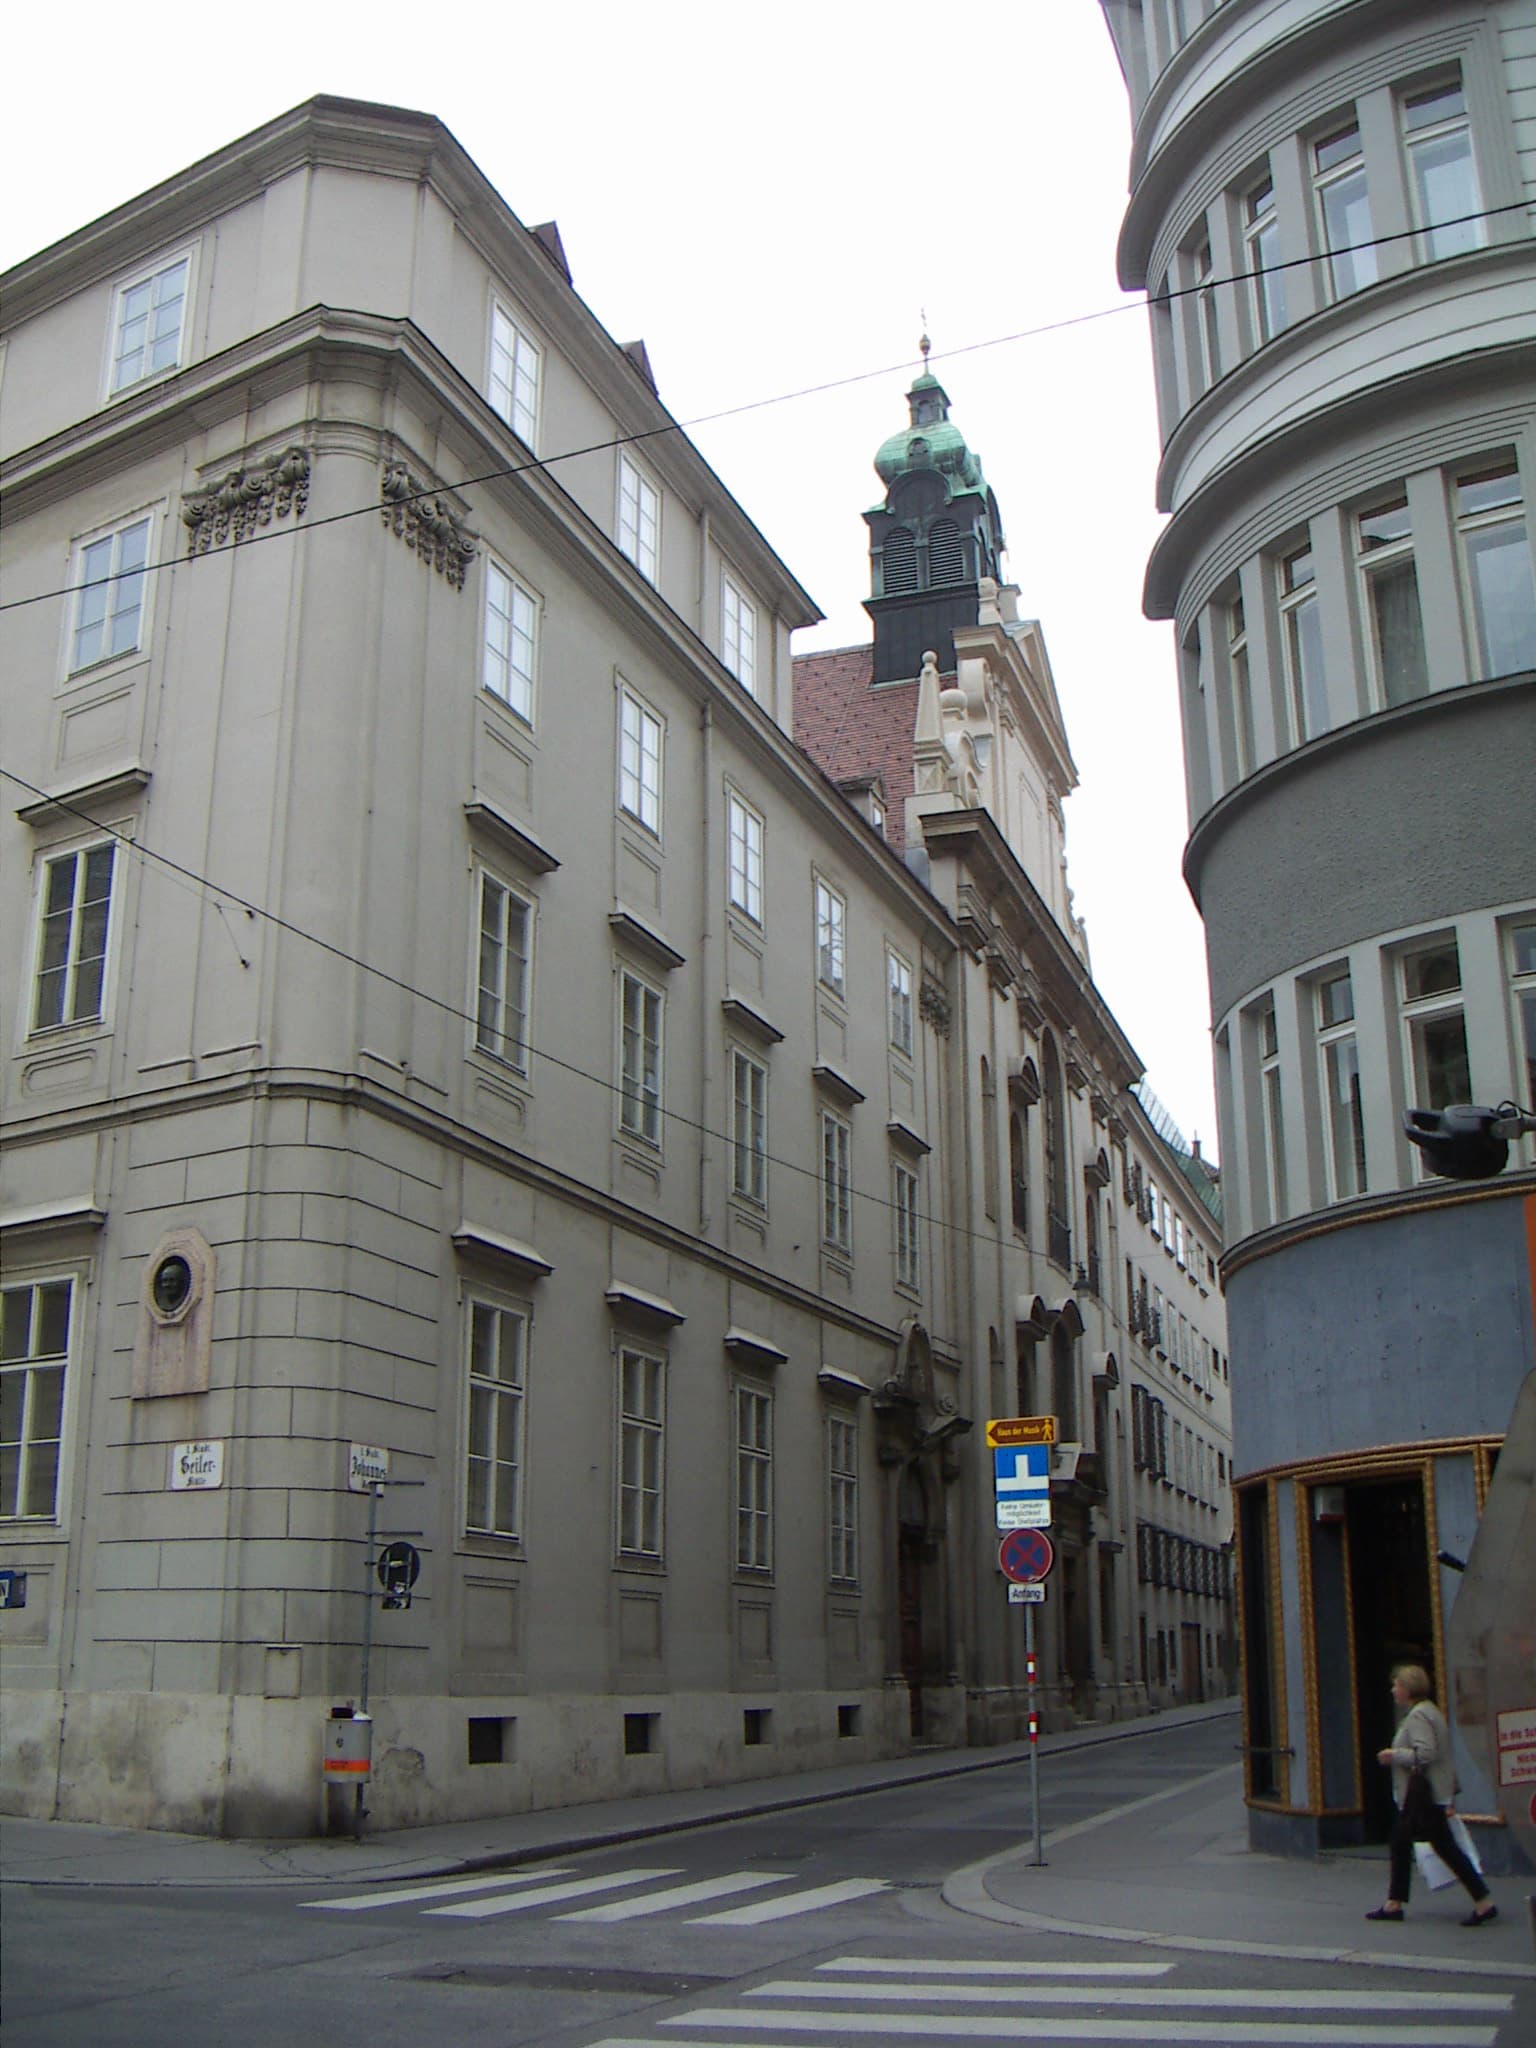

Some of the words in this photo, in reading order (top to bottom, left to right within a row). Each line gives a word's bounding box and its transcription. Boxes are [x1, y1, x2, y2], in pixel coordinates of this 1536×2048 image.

[997, 1428, 1011, 1436] Haus
[1013, 1426, 1021, 1435] der
[1023, 1425, 1040, 1434] Musik
[1012, 1588, 1041, 1600] Anfang
